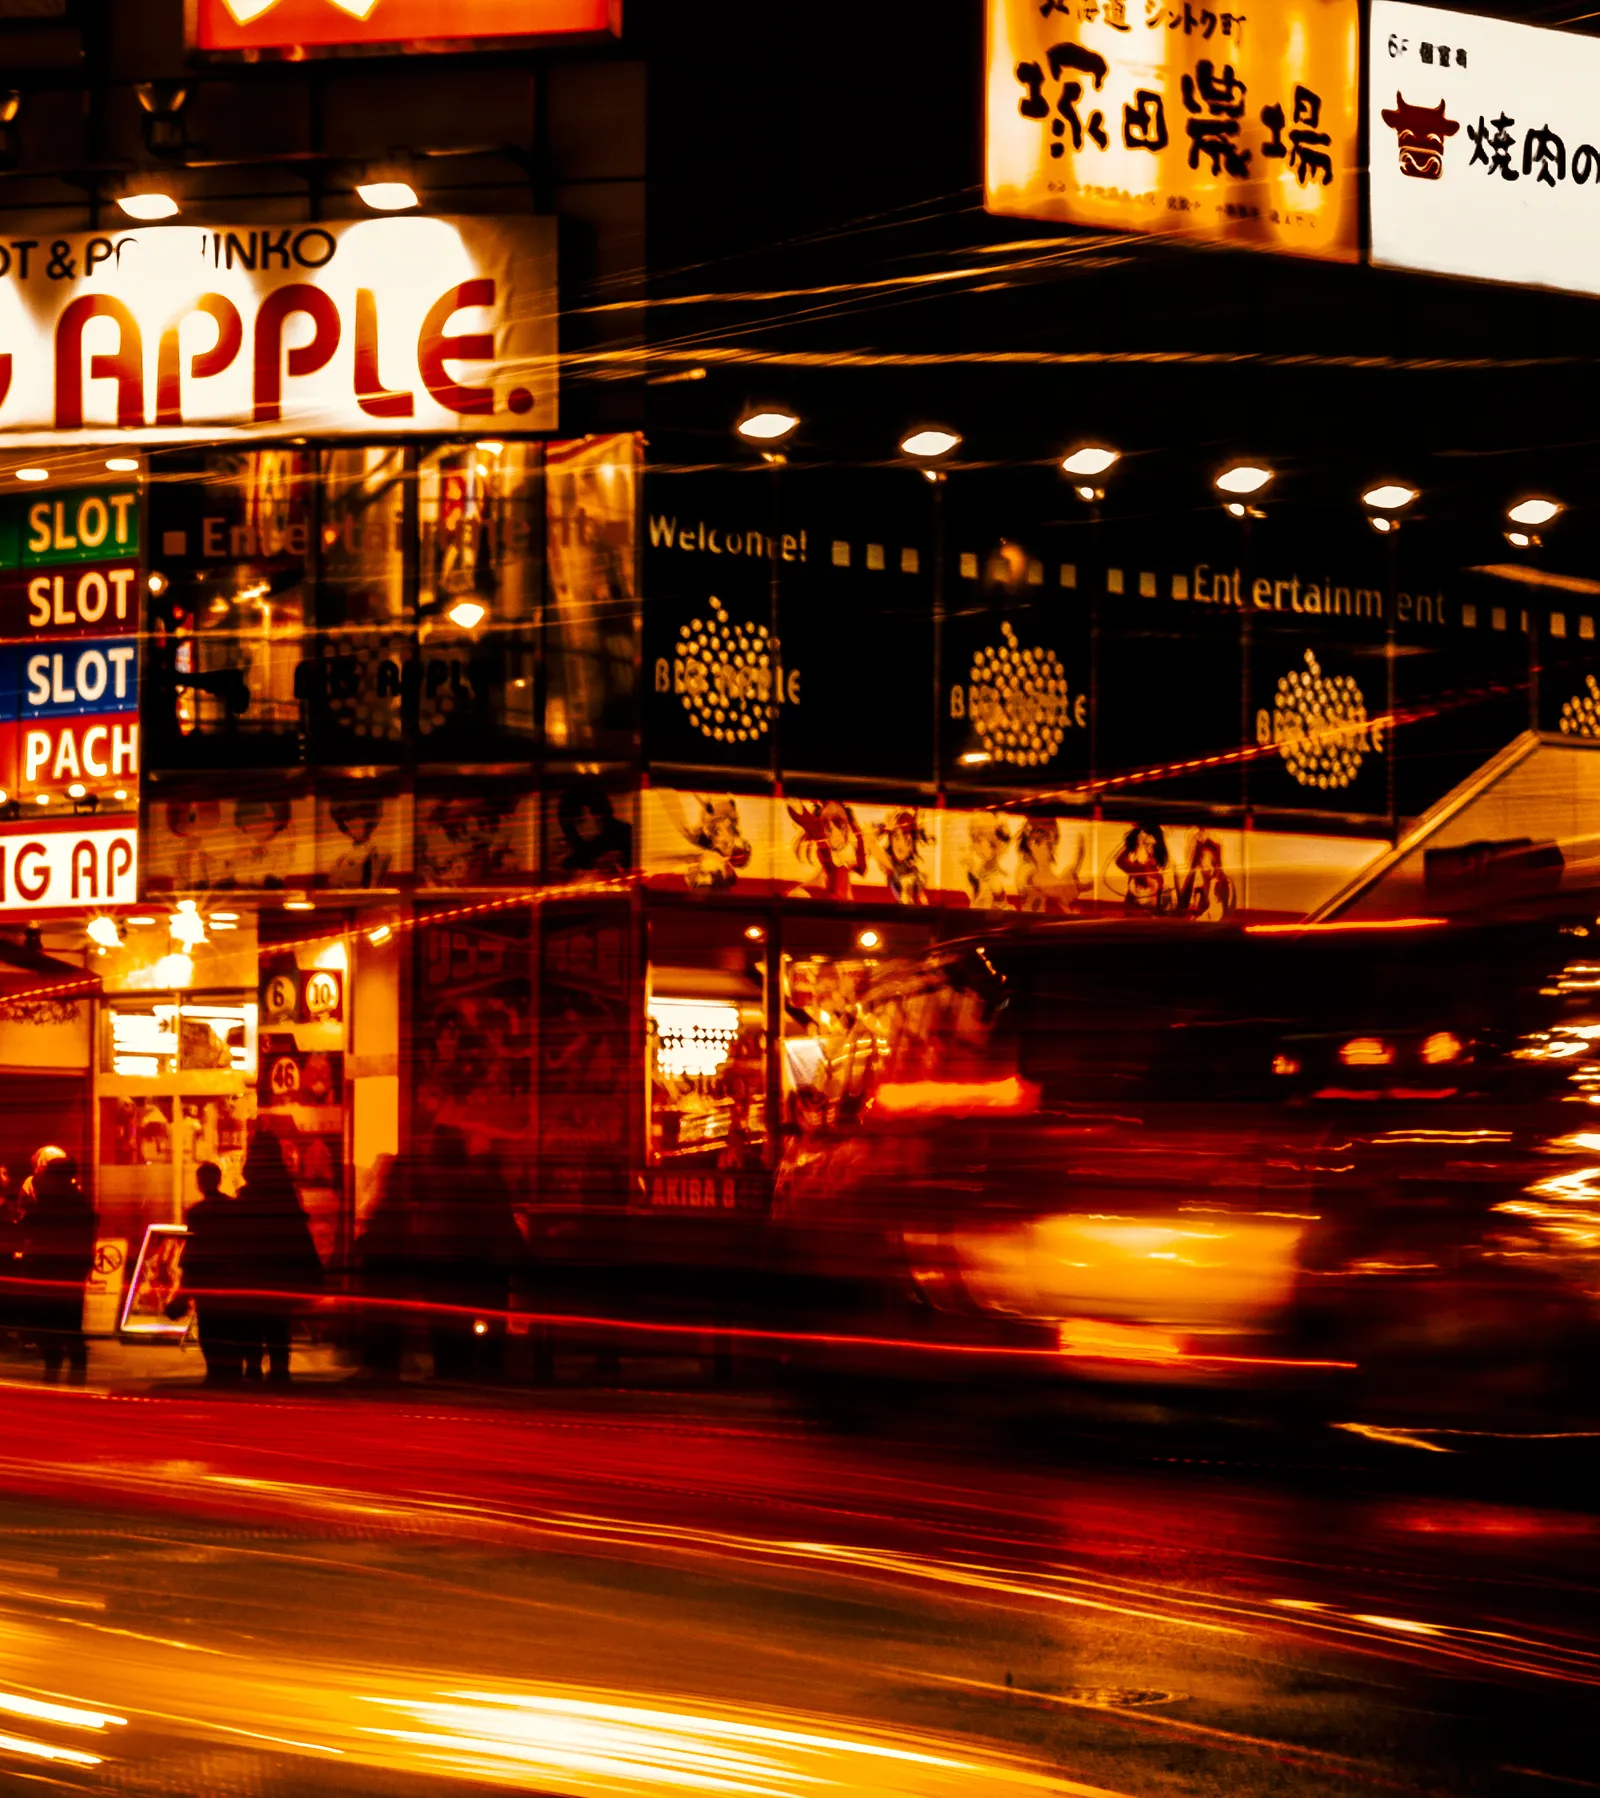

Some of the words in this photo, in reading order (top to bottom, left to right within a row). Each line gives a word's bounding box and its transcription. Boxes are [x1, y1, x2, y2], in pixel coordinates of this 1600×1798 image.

[1014, 42, 1334, 187] 塚田農場
[46, 239, 76, 281] &
[85, 227, 337, 277] PINKO
[29, 495, 136, 552] SLOT
[649, 513, 807, 562] Welcome!
[28, 569, 135, 627] SLOT
[1193, 563, 1446, 625] Entertainment
[27, 648, 135, 705] SLOT
[26, 723, 138, 782] PACH
[71, 838, 133, 899] AP
